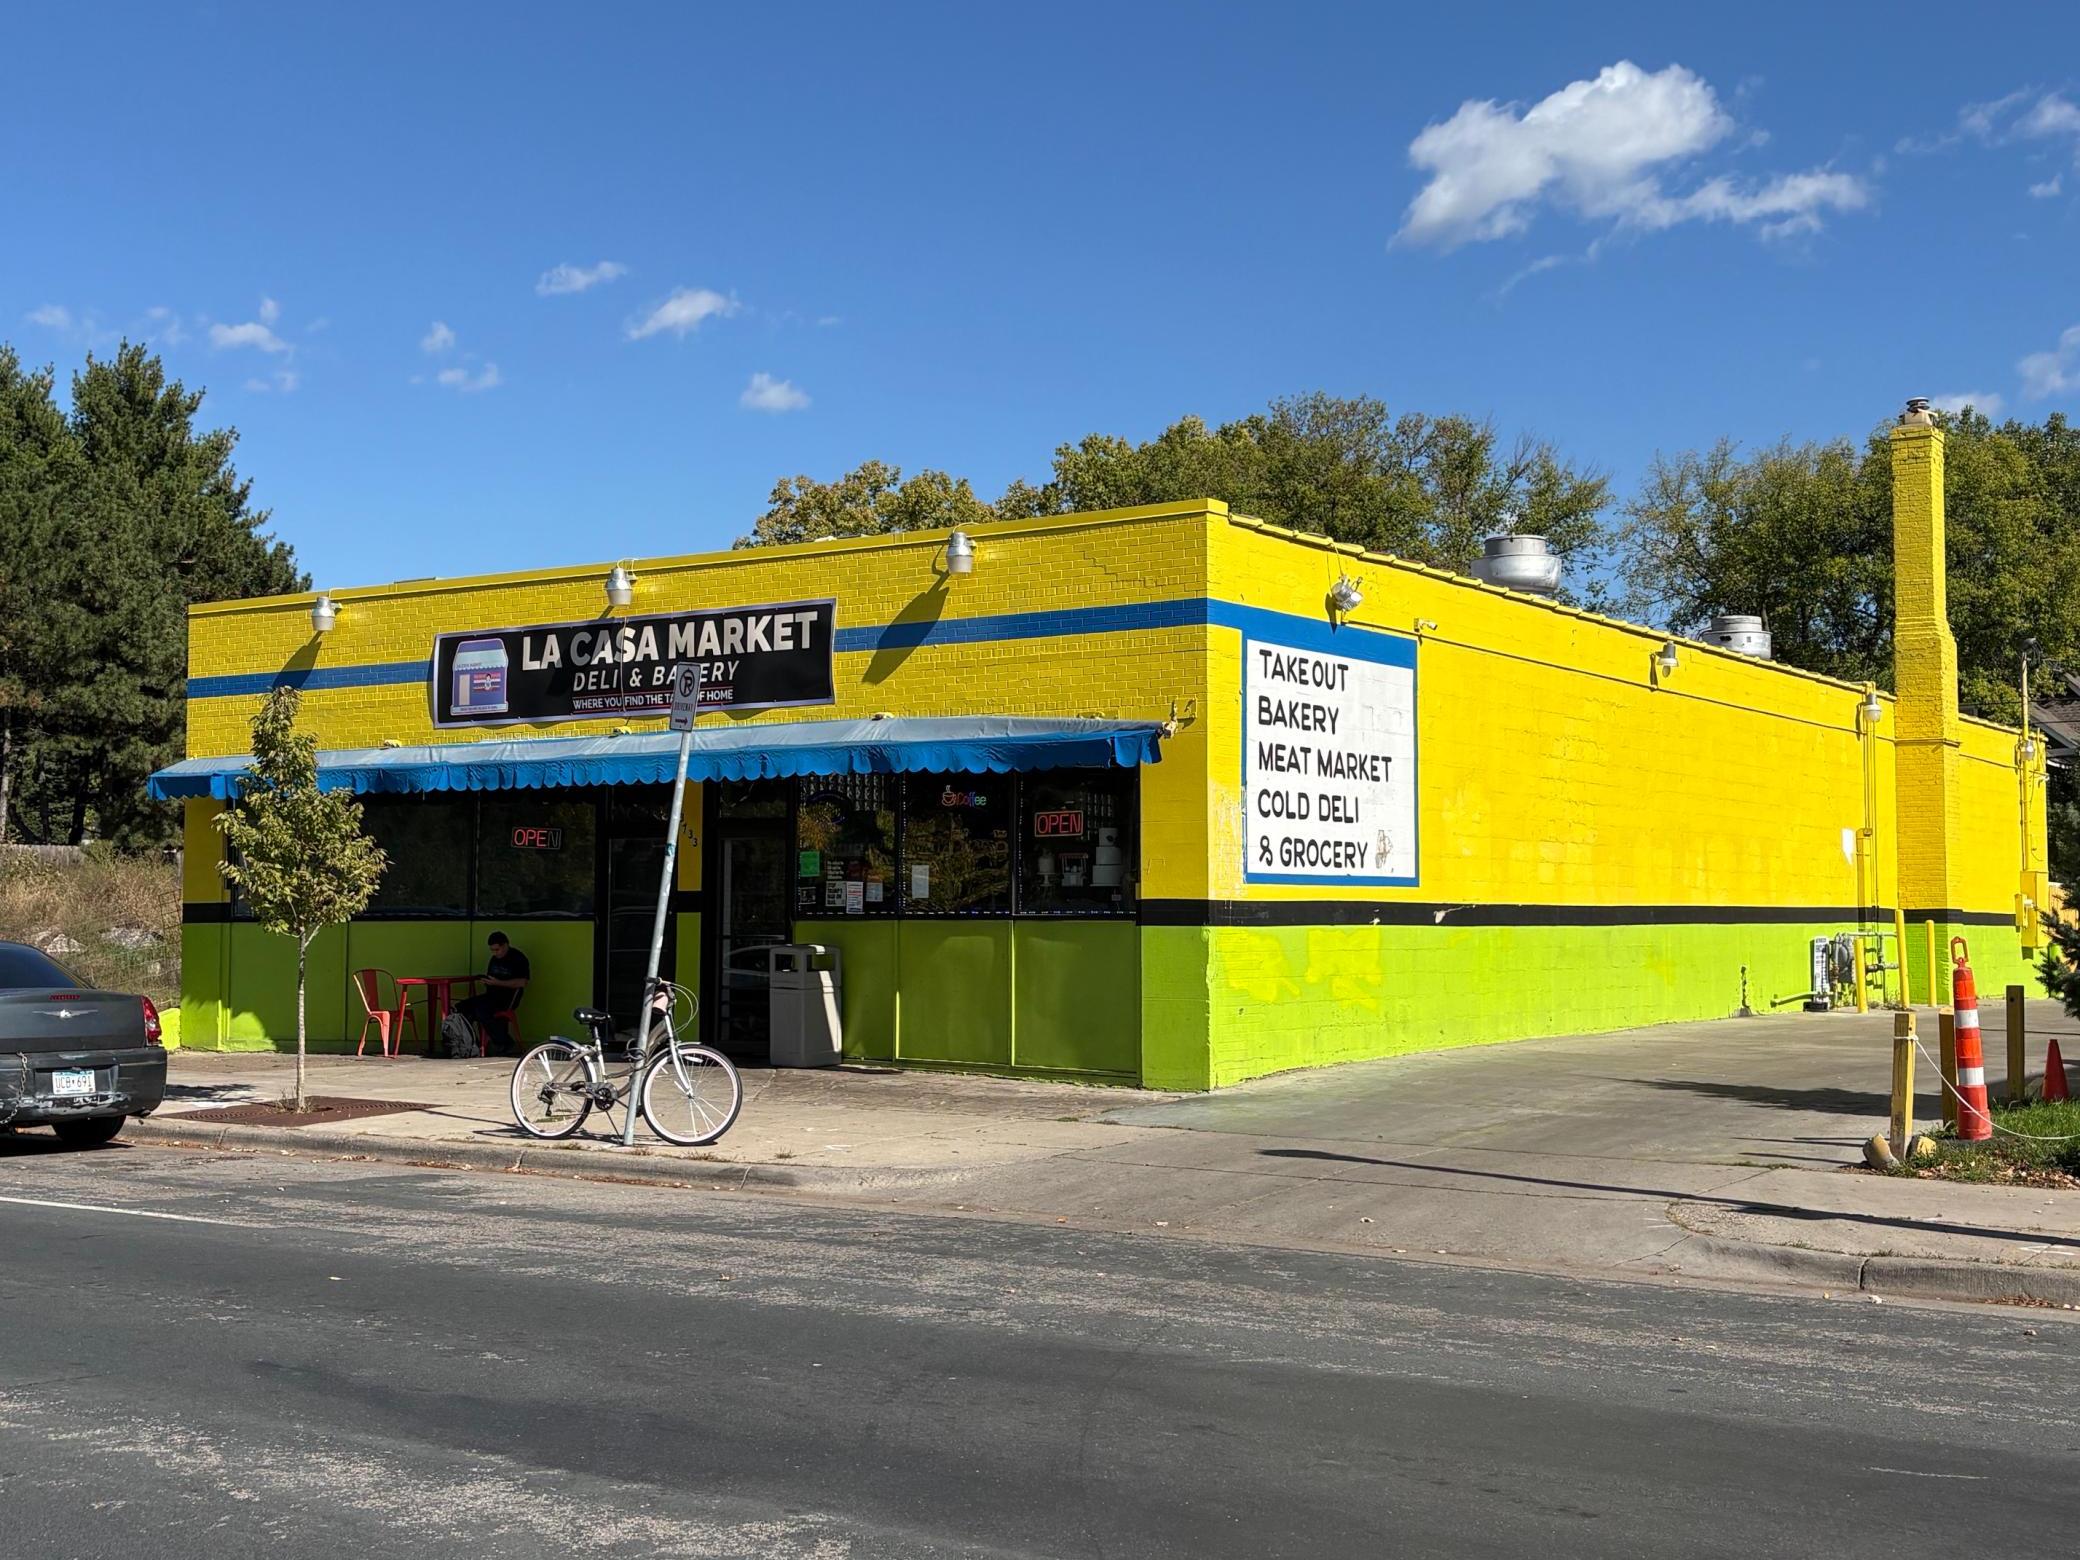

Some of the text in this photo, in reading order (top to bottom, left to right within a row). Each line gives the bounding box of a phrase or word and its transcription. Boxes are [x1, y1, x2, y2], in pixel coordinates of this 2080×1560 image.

[522, 611, 818, 671] LA CASA MARKET
[573, 660, 740, 692] DELI & BAERY
[572, 698, 604, 710] WHERE
[604, 696, 622, 708] YOU
[624, 694, 645, 706] FIND
[645, 693, 664, 705] THE
[706, 689, 734, 701] HOME
[1258, 695, 1339, 735] BAKERY
[1258, 741, 1392, 783] MEAT MARKET
[1257, 788, 1359, 824] COLD DELI
[513, 828, 560, 848] OPEN
[1037, 813, 1082, 834] OPEN
[1258, 835, 1369, 869] & GROCERY
